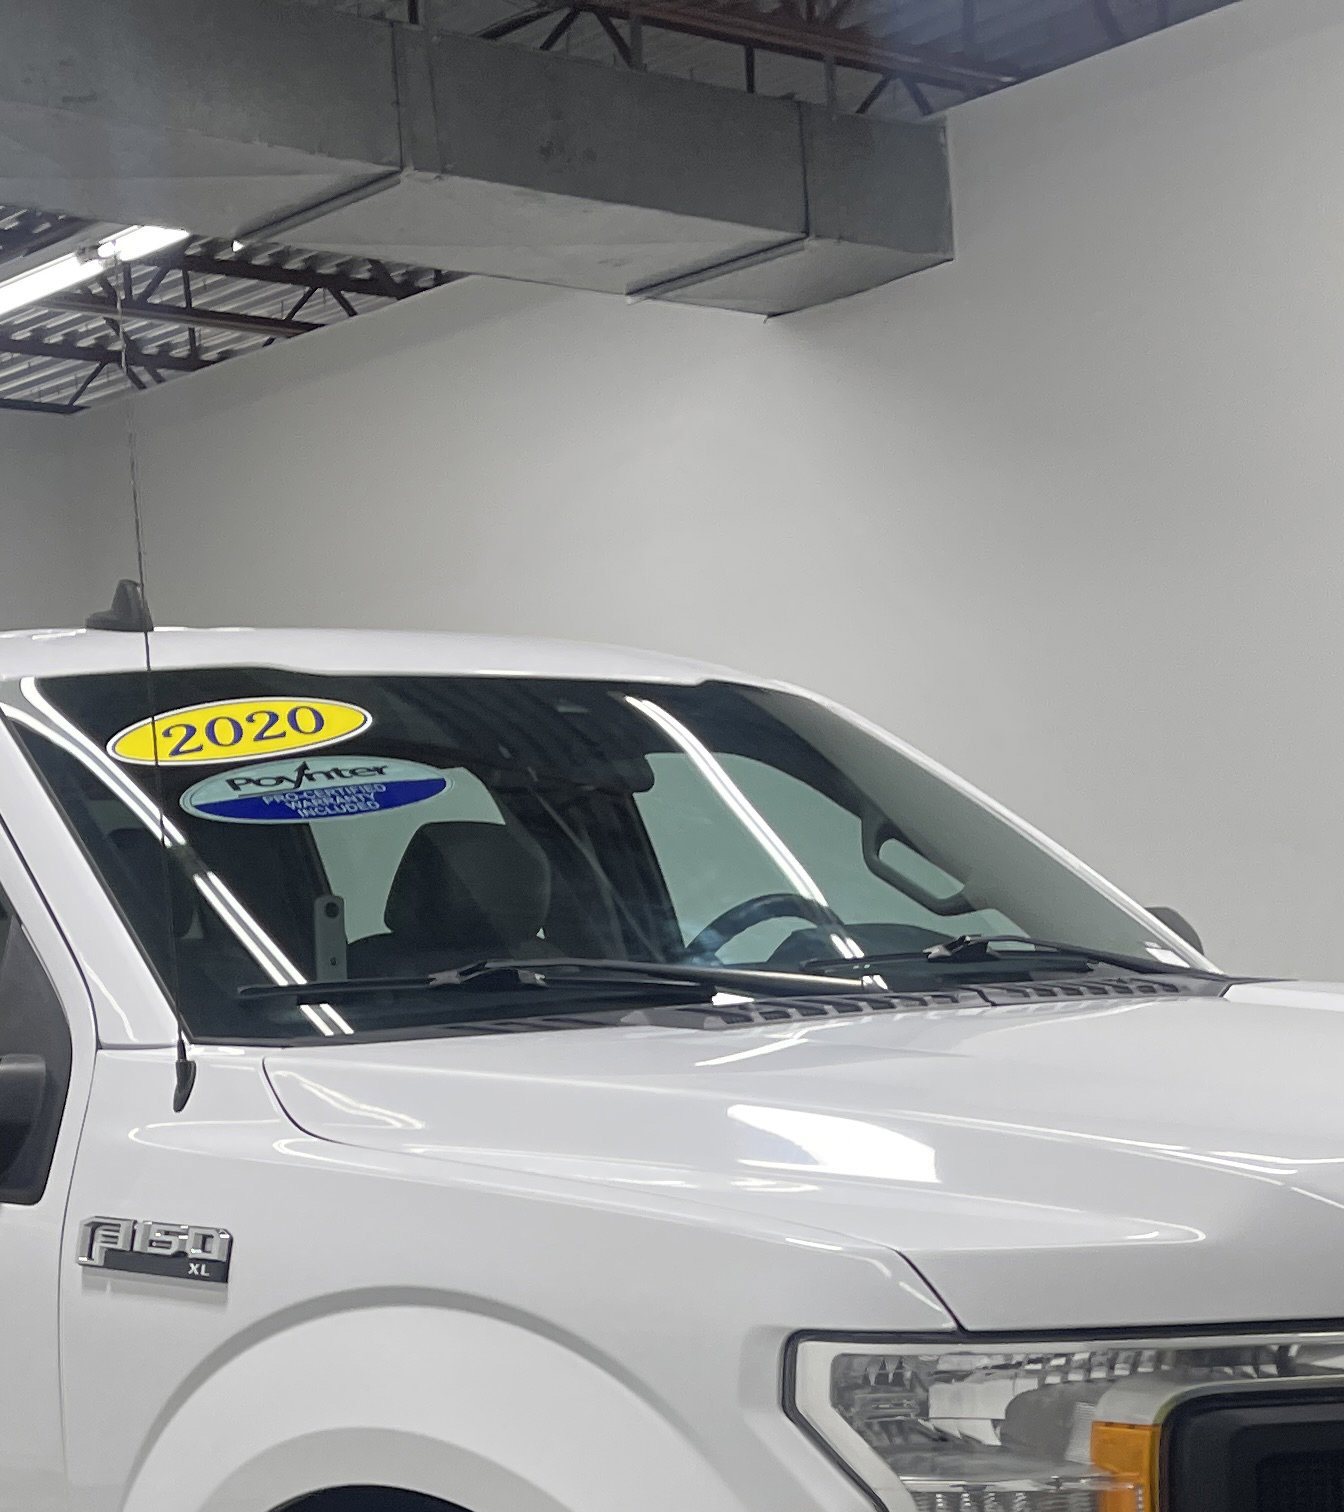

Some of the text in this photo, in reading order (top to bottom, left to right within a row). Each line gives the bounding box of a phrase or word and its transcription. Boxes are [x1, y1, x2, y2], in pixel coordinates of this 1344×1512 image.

[162, 705, 325, 757] 2020
[225, 760, 389, 791] Poynter
[262, 783, 388, 805] PRO-CERTIFIED
[285, 792, 377, 811] WARRANTY
[297, 801, 381, 818] INCLUDED
[188, 1262, 210, 1277] XL
